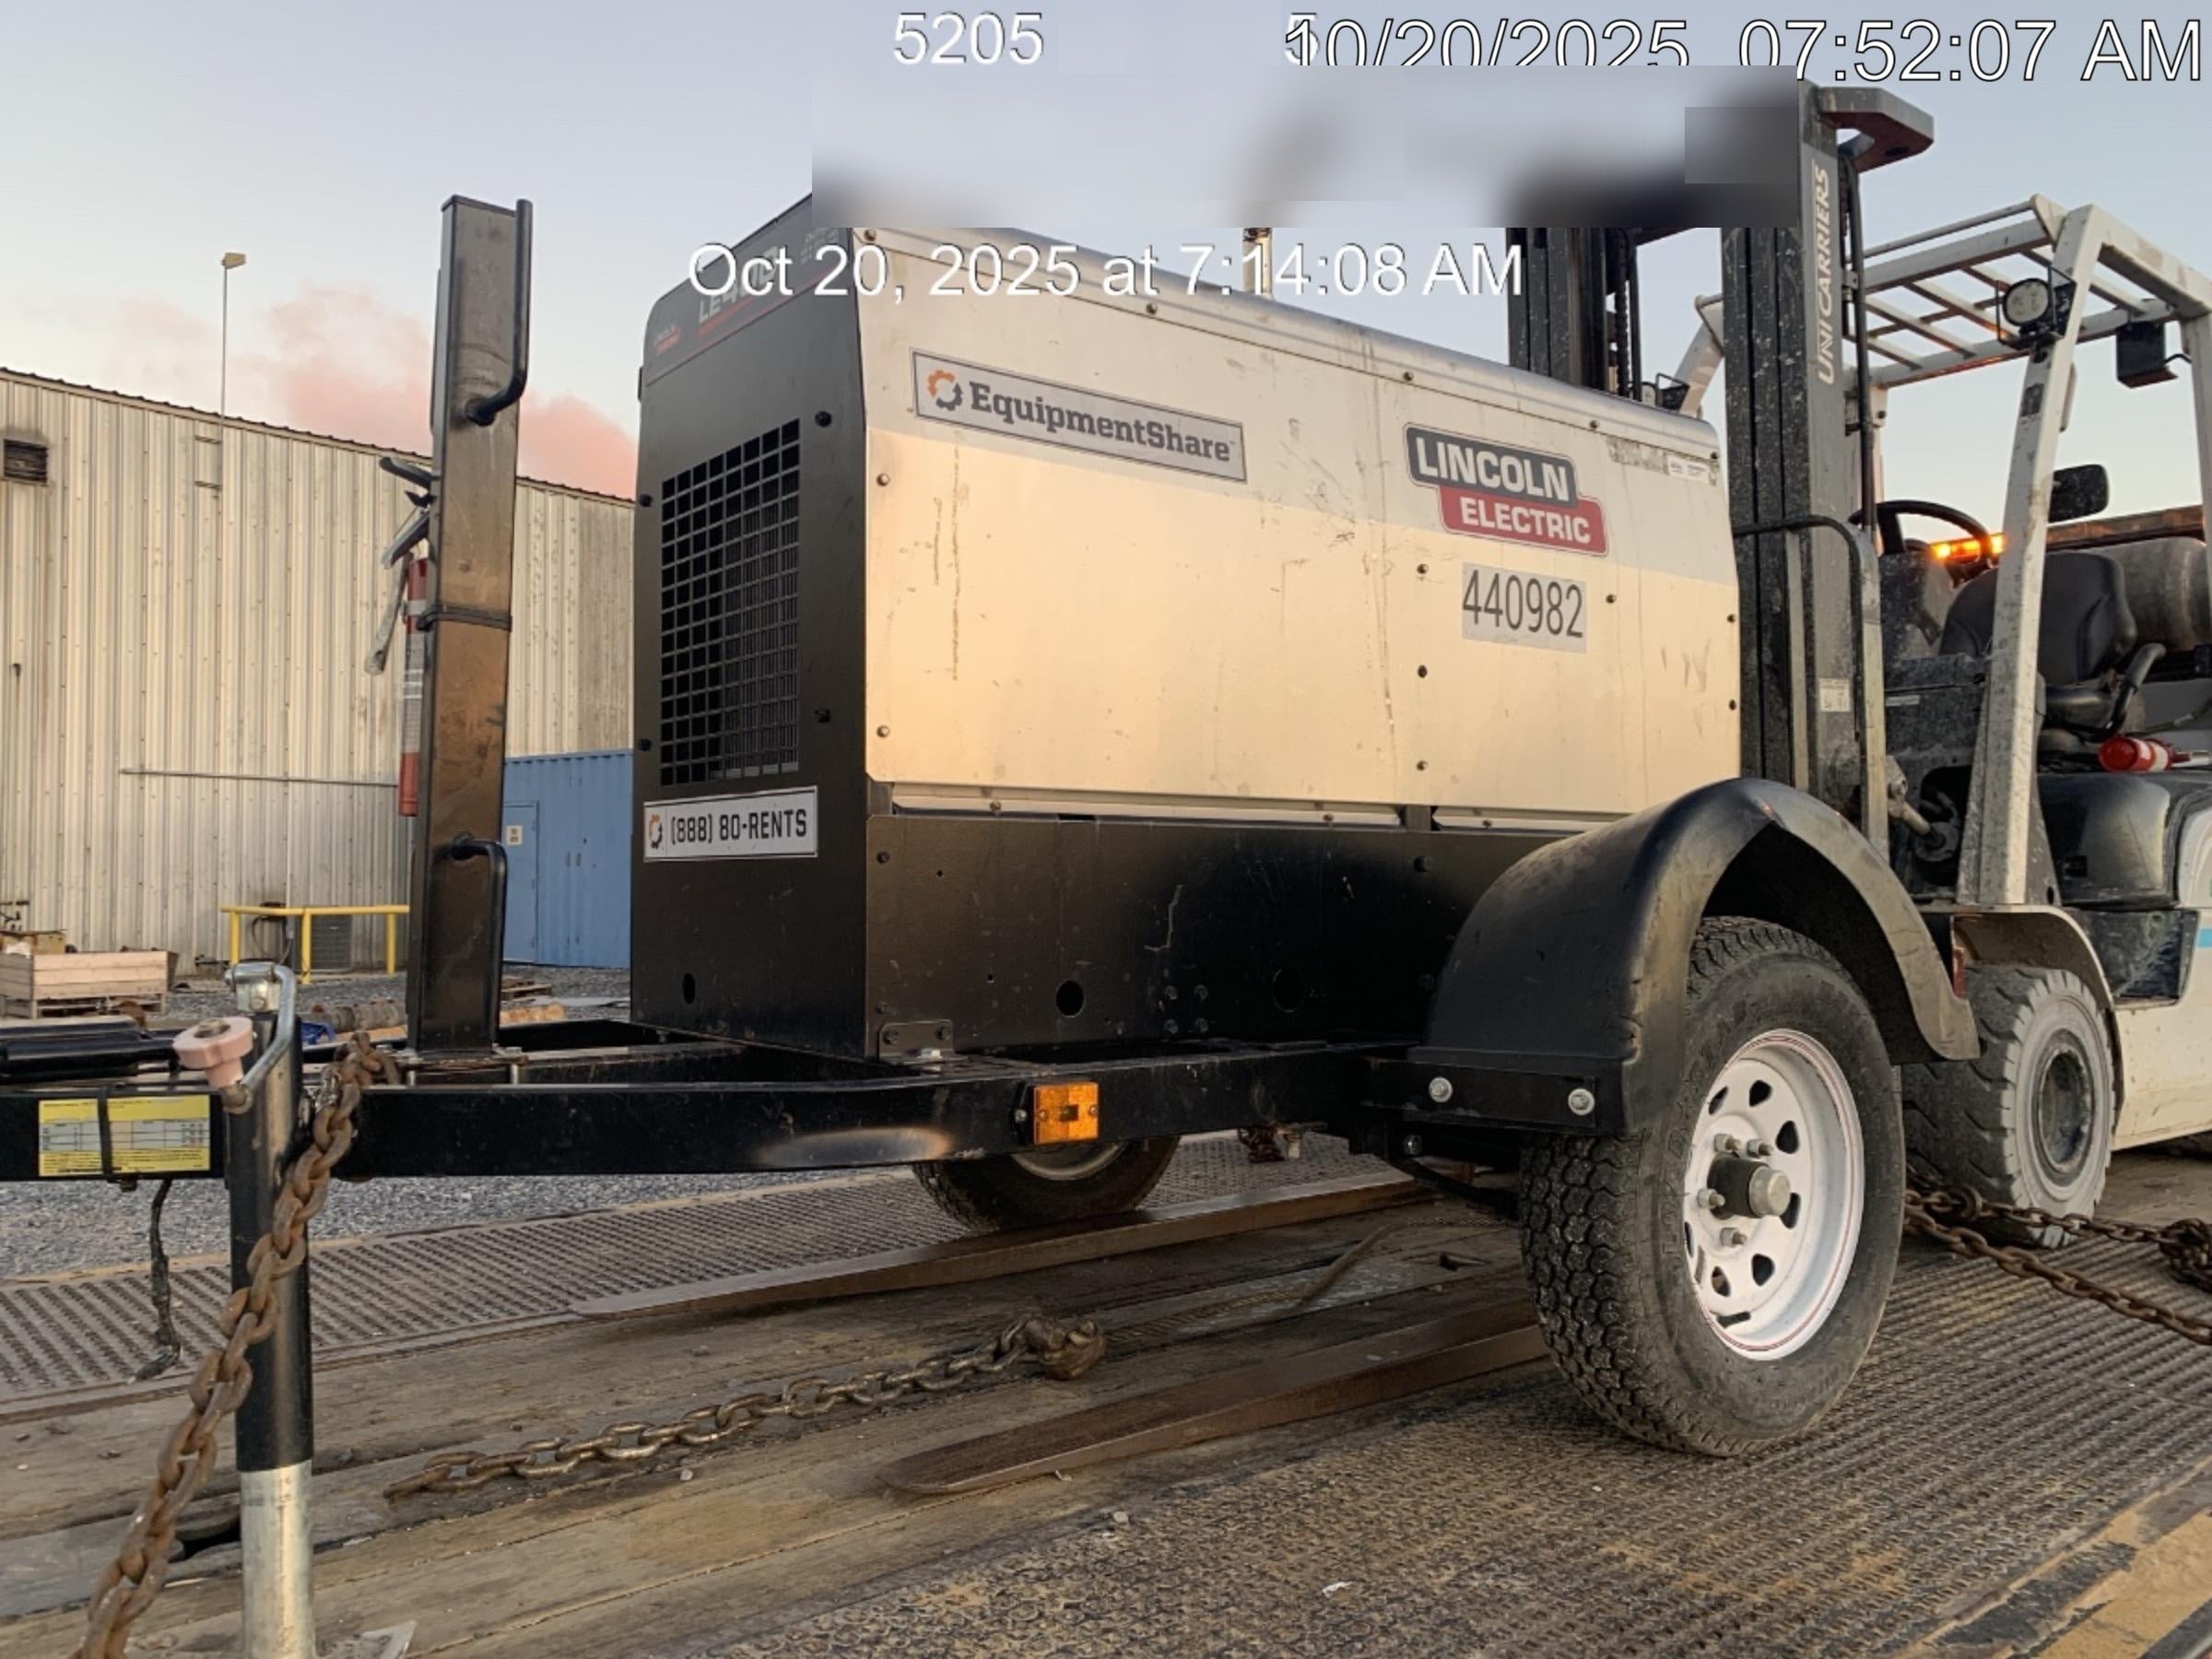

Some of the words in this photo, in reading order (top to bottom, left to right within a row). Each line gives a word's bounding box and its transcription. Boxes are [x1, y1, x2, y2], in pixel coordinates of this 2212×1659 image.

[1813, 159, 1835, 385] UNICARRIERS
[969, 381, 1230, 463] EquipmentShare
[1415, 437, 1570, 502] LINCOLN
[1459, 496, 1592, 545] ELECTRIC
[1462, 569, 1584, 639] 440982
[671, 814, 712, 845] (888)
[719, 808, 807, 841] 80-RENTS
